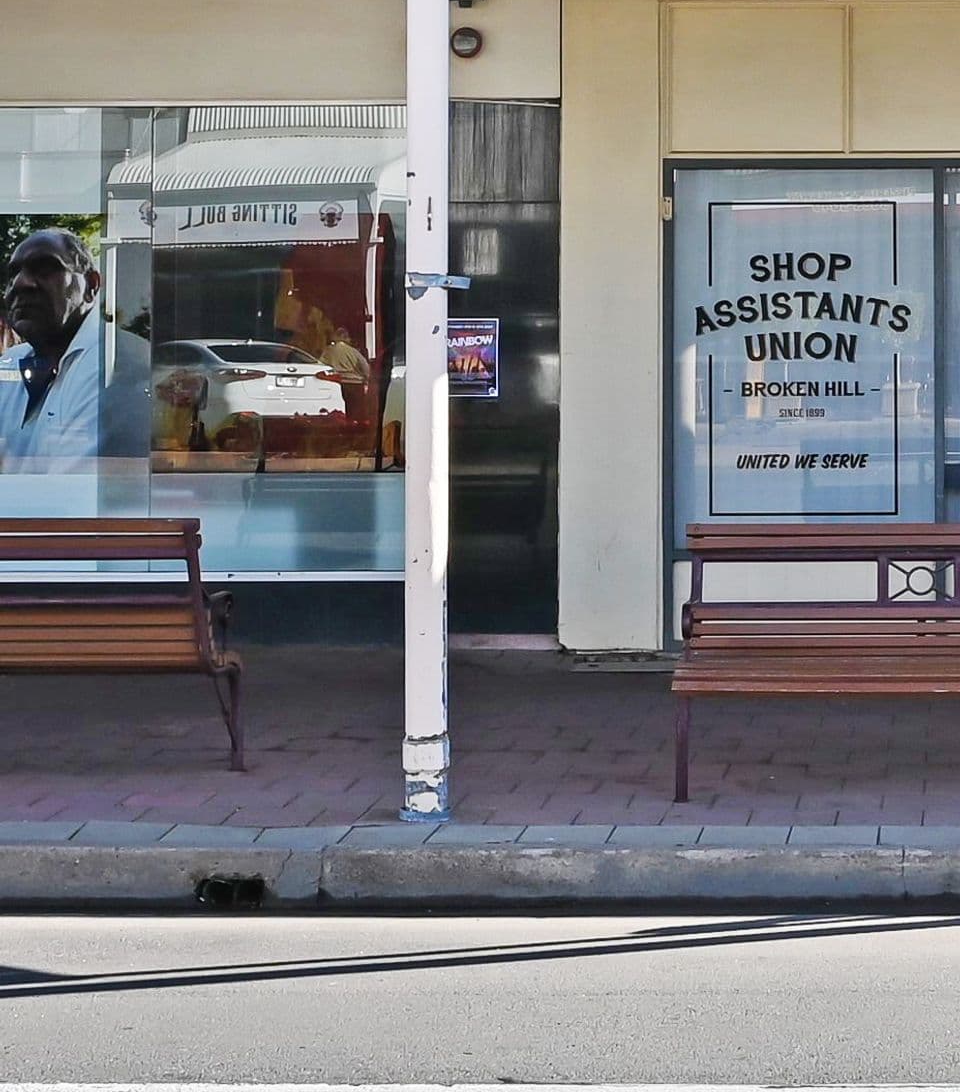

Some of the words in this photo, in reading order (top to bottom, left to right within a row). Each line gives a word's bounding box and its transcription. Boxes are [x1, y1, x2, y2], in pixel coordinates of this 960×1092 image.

[749, 252, 851, 283] SHOP
[695, 291, 912, 336] ASSISTANTS
[744, 331, 858, 363] UNION
[741, 381, 819, 397] BROKEN
[824, 381, 865, 397] HILL
[778, 408, 804, 418] SINCE
[736, 454, 790, 469] UNITED
[794, 454, 818, 469] WE
[821, 454, 869, 469] SERVE
